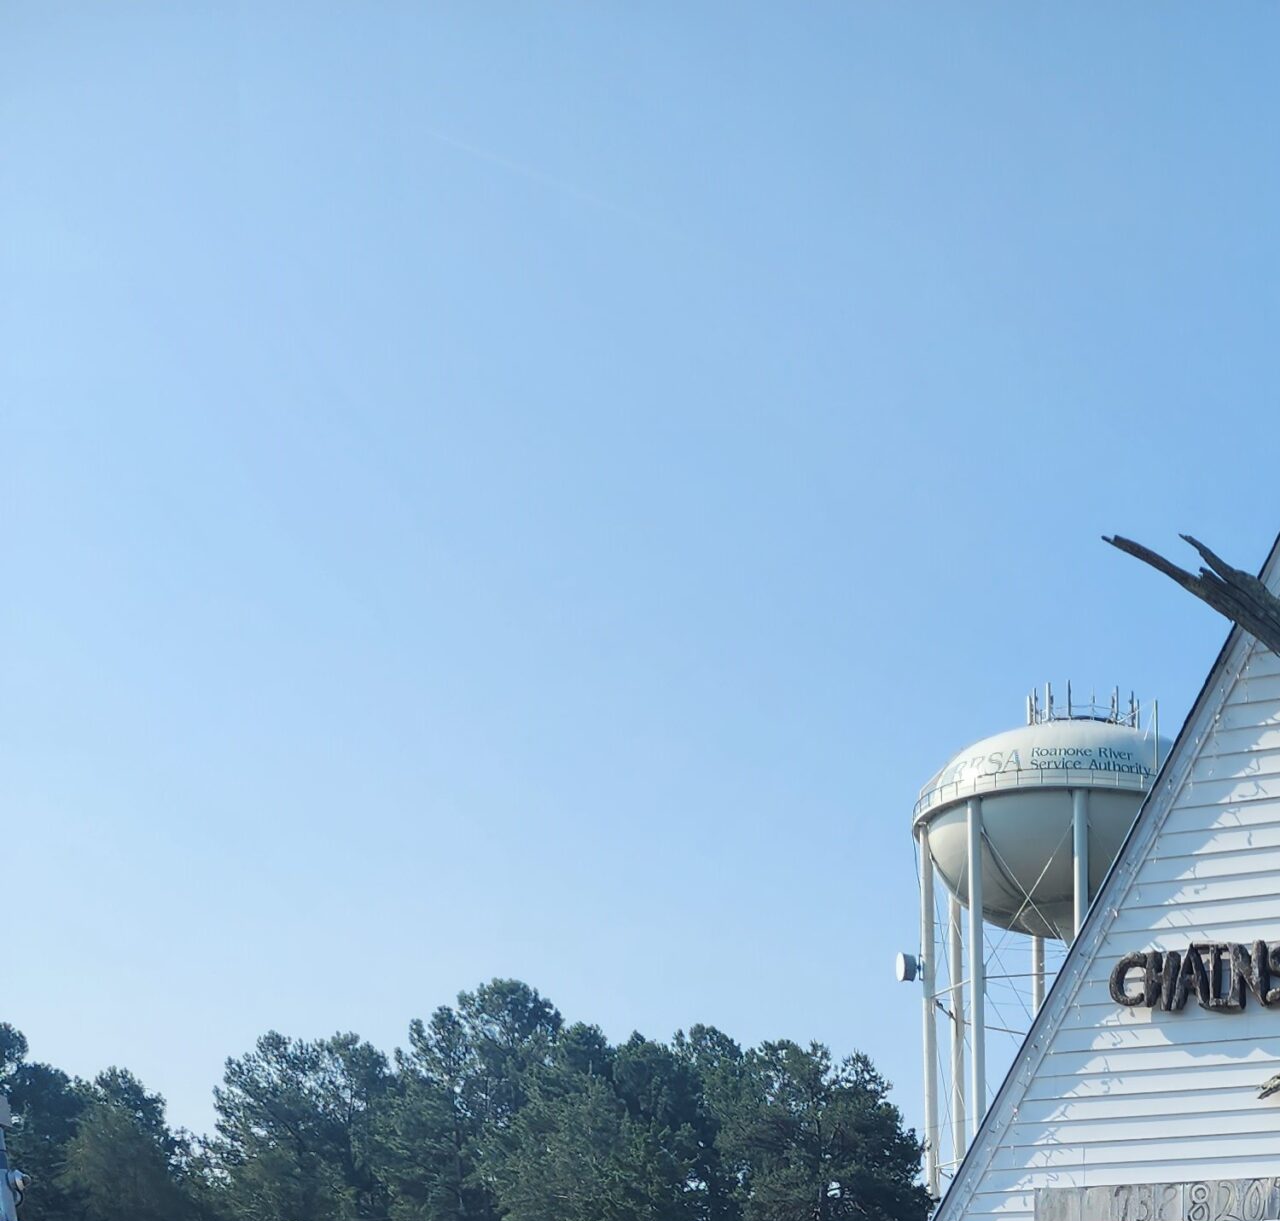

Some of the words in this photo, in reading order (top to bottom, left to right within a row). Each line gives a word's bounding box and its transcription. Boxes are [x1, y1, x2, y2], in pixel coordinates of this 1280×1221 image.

[1031, 746, 1093, 758] Roanoke
[1098, 747, 1133, 761] River
[1030, 759, 1083, 770] Service
[1089, 759, 1151, 779] Authority
